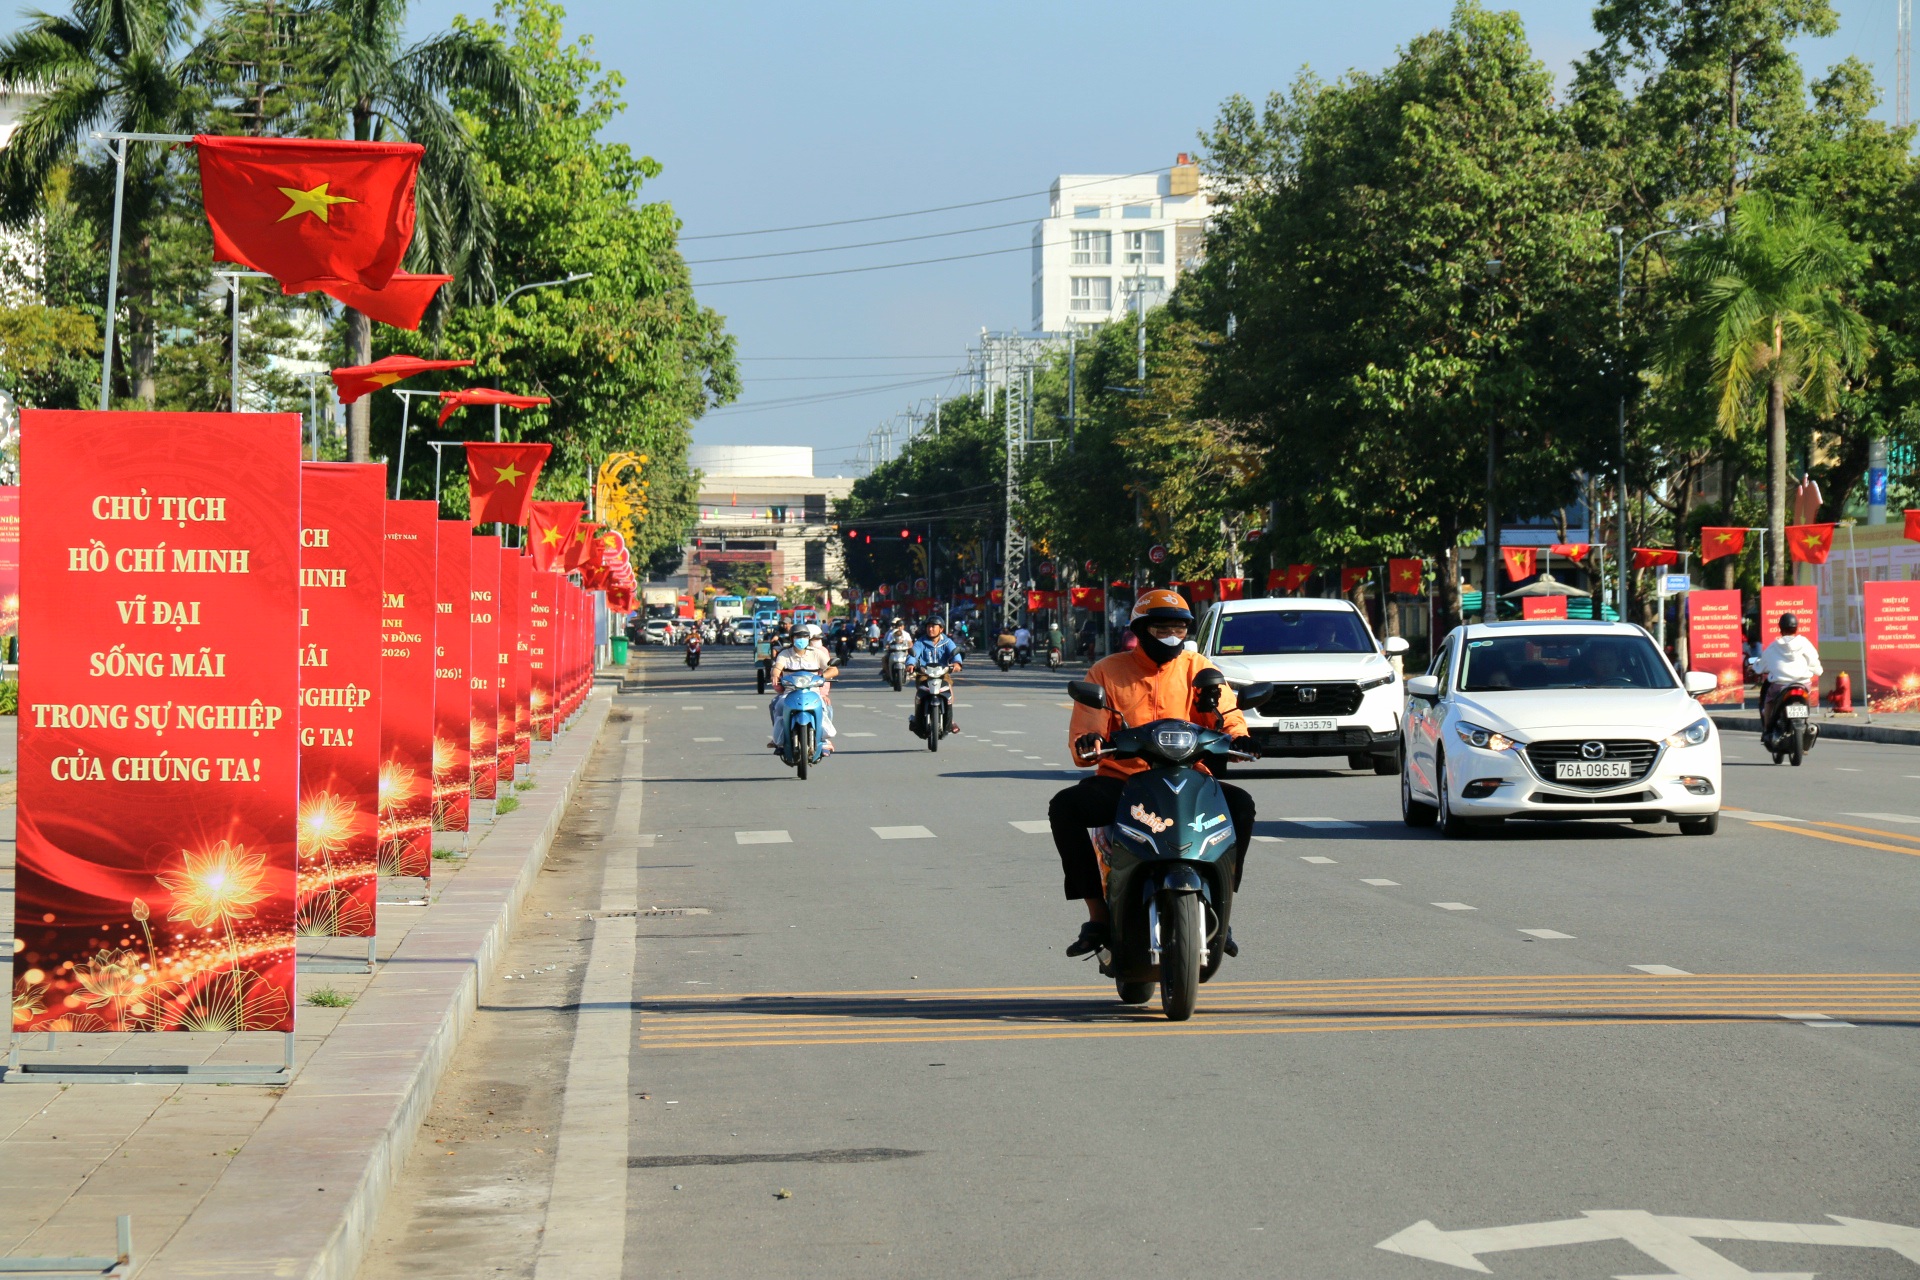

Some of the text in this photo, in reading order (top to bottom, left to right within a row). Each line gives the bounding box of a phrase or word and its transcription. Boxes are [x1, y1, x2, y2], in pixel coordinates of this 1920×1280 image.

[92, 488, 226, 528] CHỦ TỊCH
[301, 529, 329, 548] CH
[68, 539, 249, 573] HỒ CHÍ MINH
[116, 595, 200, 632] VĨ ĐẠI
[437, 603, 452, 613] NH
[382, 619, 402, 627] INH
[532, 619, 547, 627] TRÒ
[391, 631, 422, 643] ĐỒNG
[517, 641, 528, 651] ẾN
[531, 648, 544, 656] ỊCH
[382, 649, 410, 658] 2026)
[90, 644, 225, 677] SỐNG MÃI
[436, 668, 462, 680] 026)!
[471, 677, 487, 689] ỚI!
[32, 699, 282, 737] TRONG SỰ NGHIỆP
[1284, 721, 1332, 730] 76A-335.79
[320, 728, 353, 747] TA!
[51, 749, 260, 782] CỦA CHÚNG TA!
[1560, 764, 1626, 776] 76A-096.54
